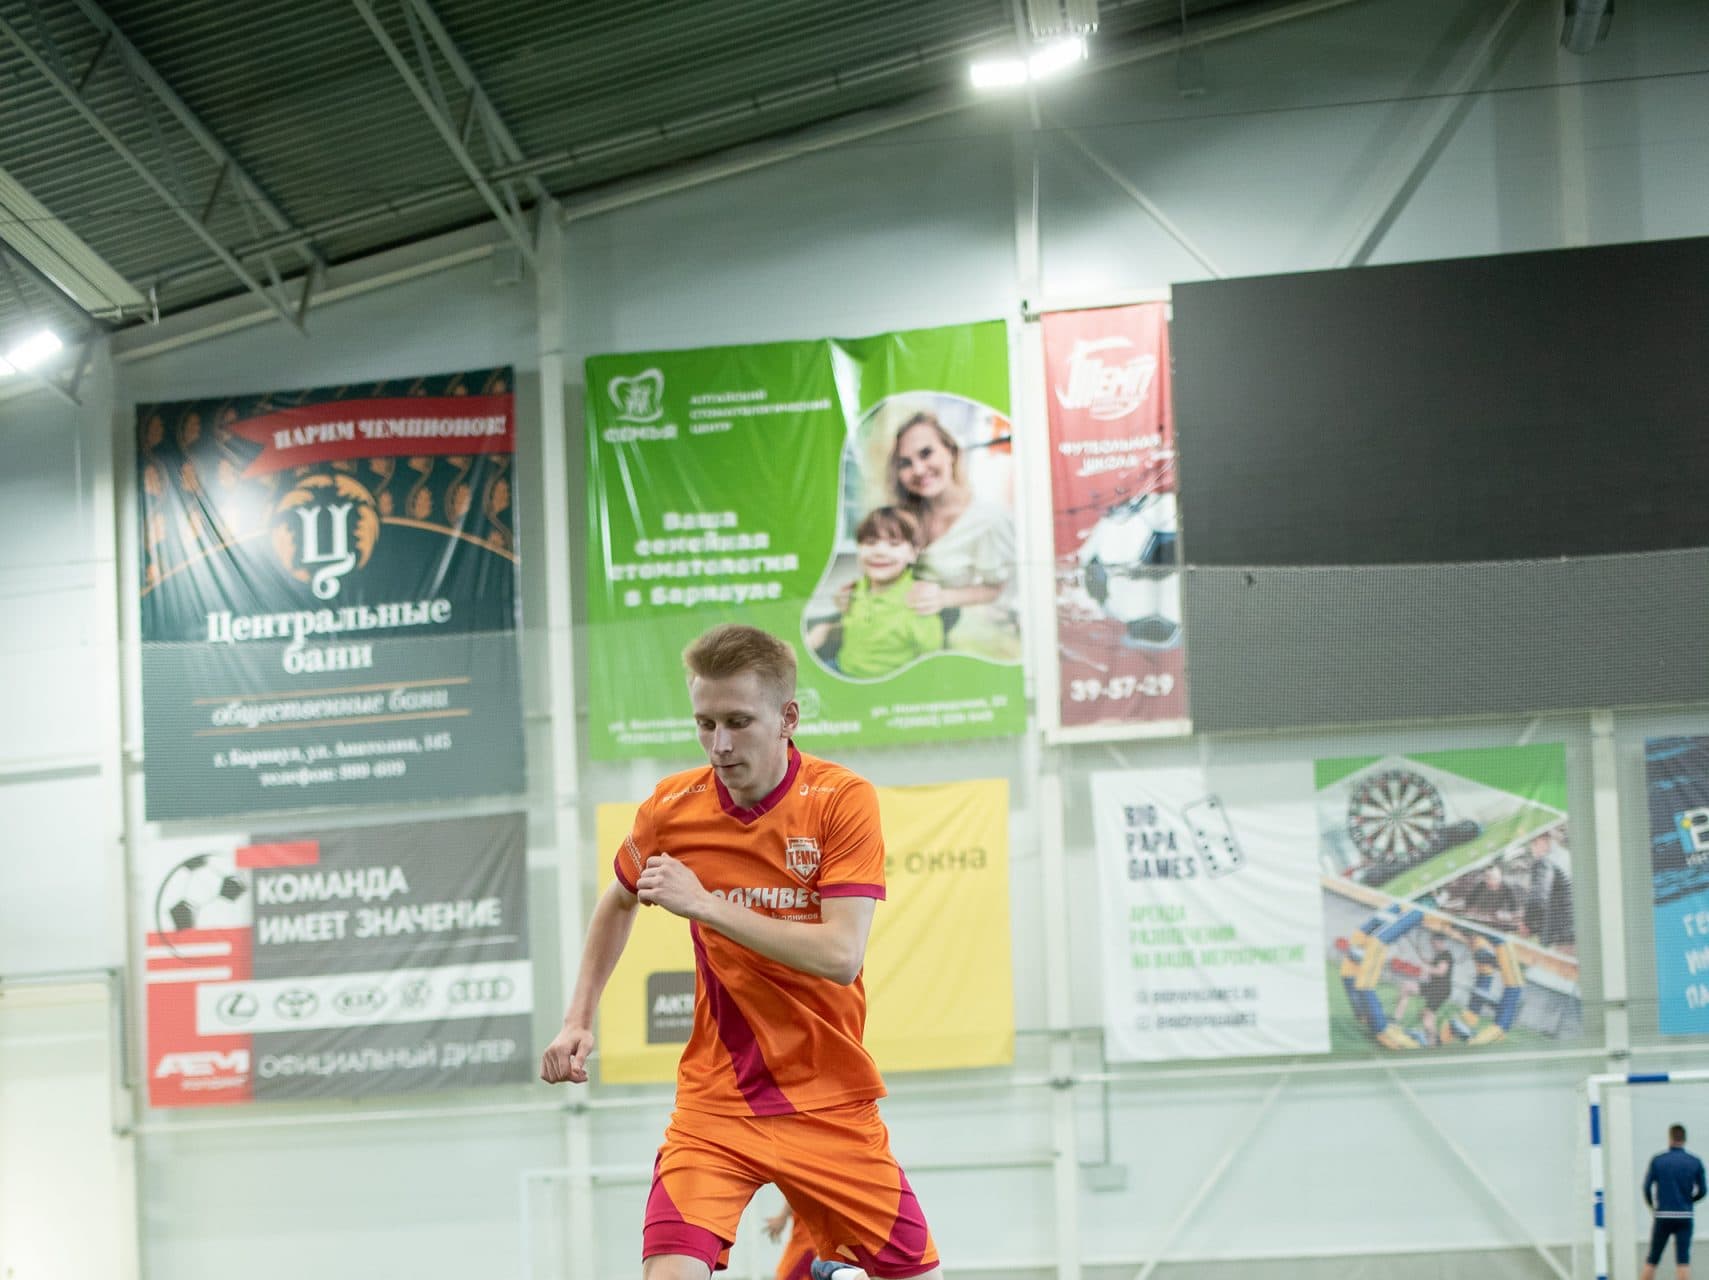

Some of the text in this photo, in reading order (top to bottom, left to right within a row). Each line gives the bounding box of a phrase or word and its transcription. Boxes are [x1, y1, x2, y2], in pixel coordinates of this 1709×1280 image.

[273, 420, 356, 450] ПАРИМ
[296, 502, 356, 600] Ц
[207, 598, 452, 646] Центральные
[283, 642, 374, 675] бани
[904, 847, 988, 876] окна
[257, 864, 410, 905] КОМАНДА
[258, 897, 503, 946] ИМЕЕТ ЗНАЧЕНИЕ
[258, 1037, 516, 1080] ОФИЦИАЛЬНЫЙ ДИЛЕР
